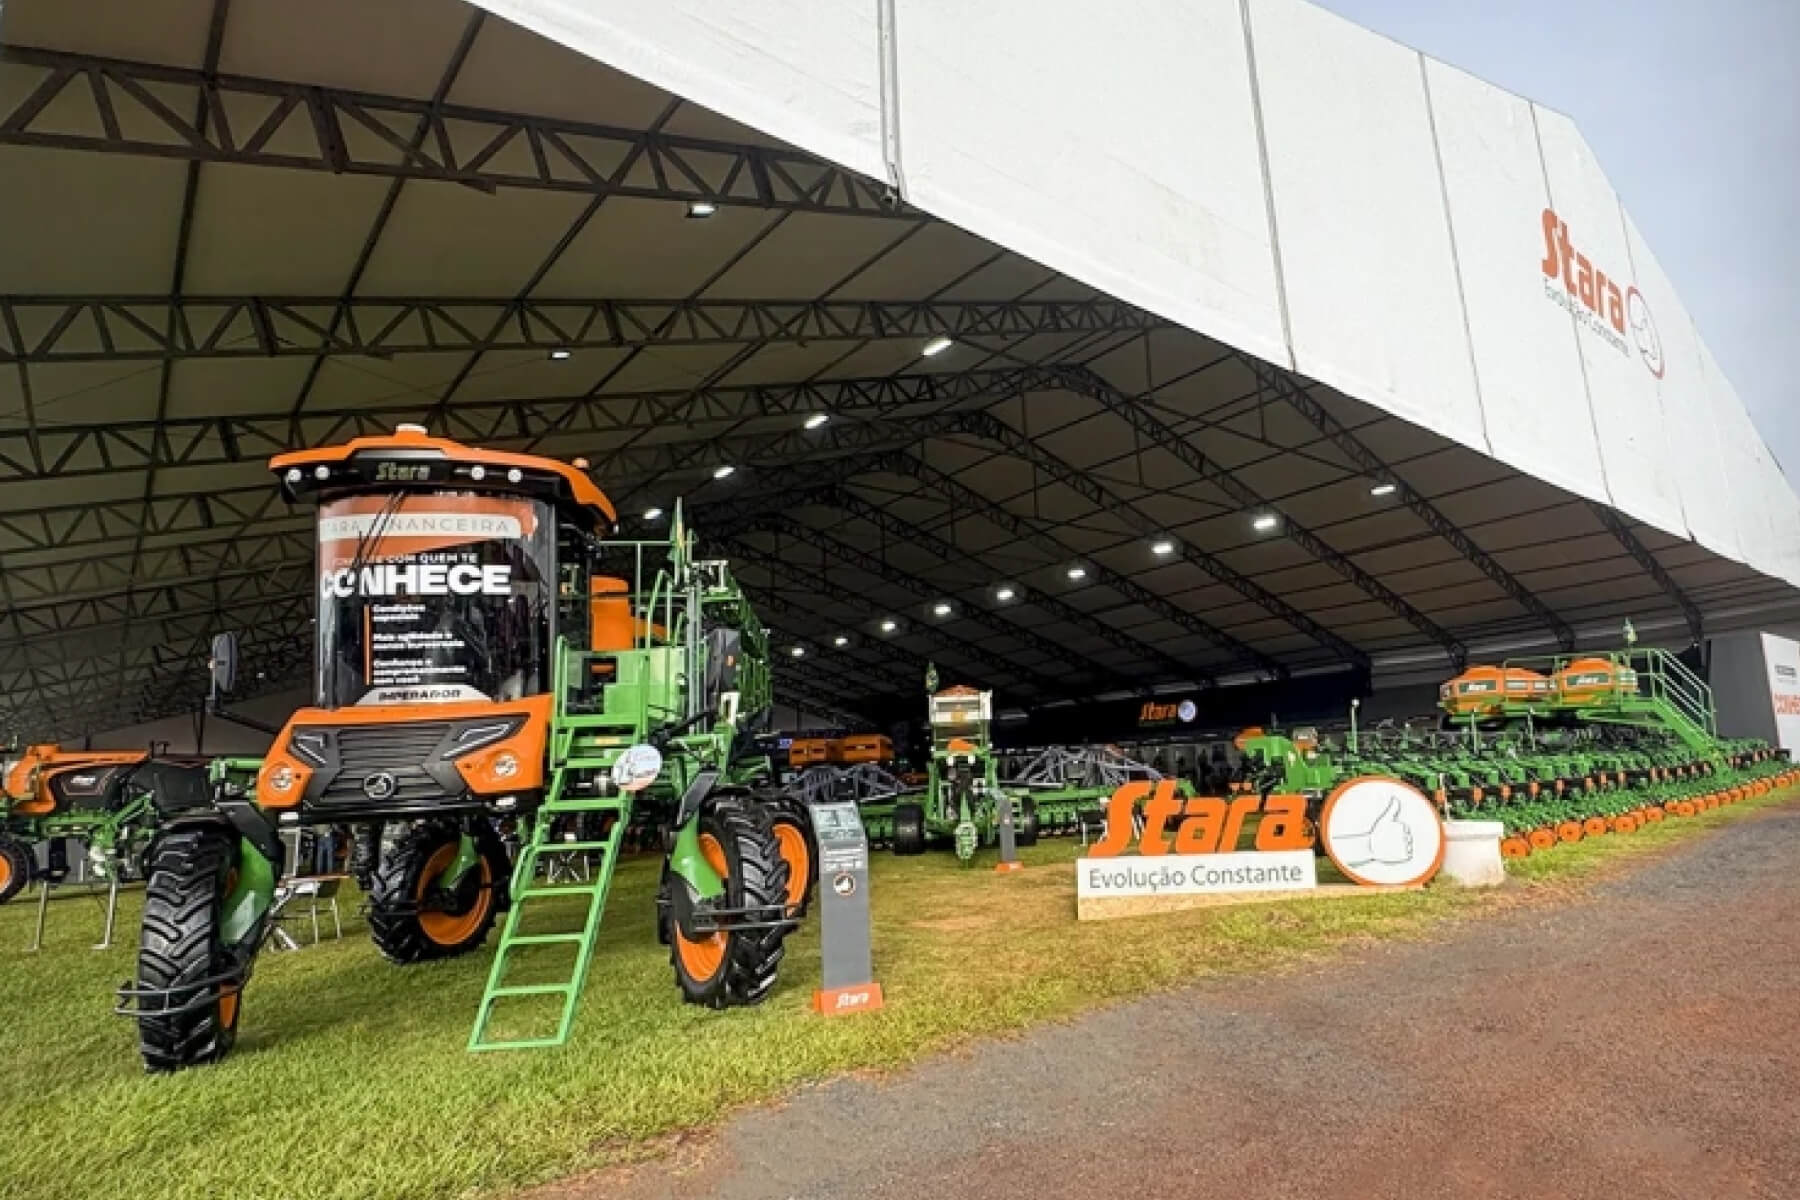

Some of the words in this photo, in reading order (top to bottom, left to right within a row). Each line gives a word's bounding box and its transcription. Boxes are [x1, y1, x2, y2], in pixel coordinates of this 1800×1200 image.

[1541, 207, 1625, 336] Stara
[376, 461, 431, 481] Stara
[1088, 778, 1315, 858] Stara
[1089, 865, 1186, 891] Evolução
[1191, 862, 1303, 886] Constante
